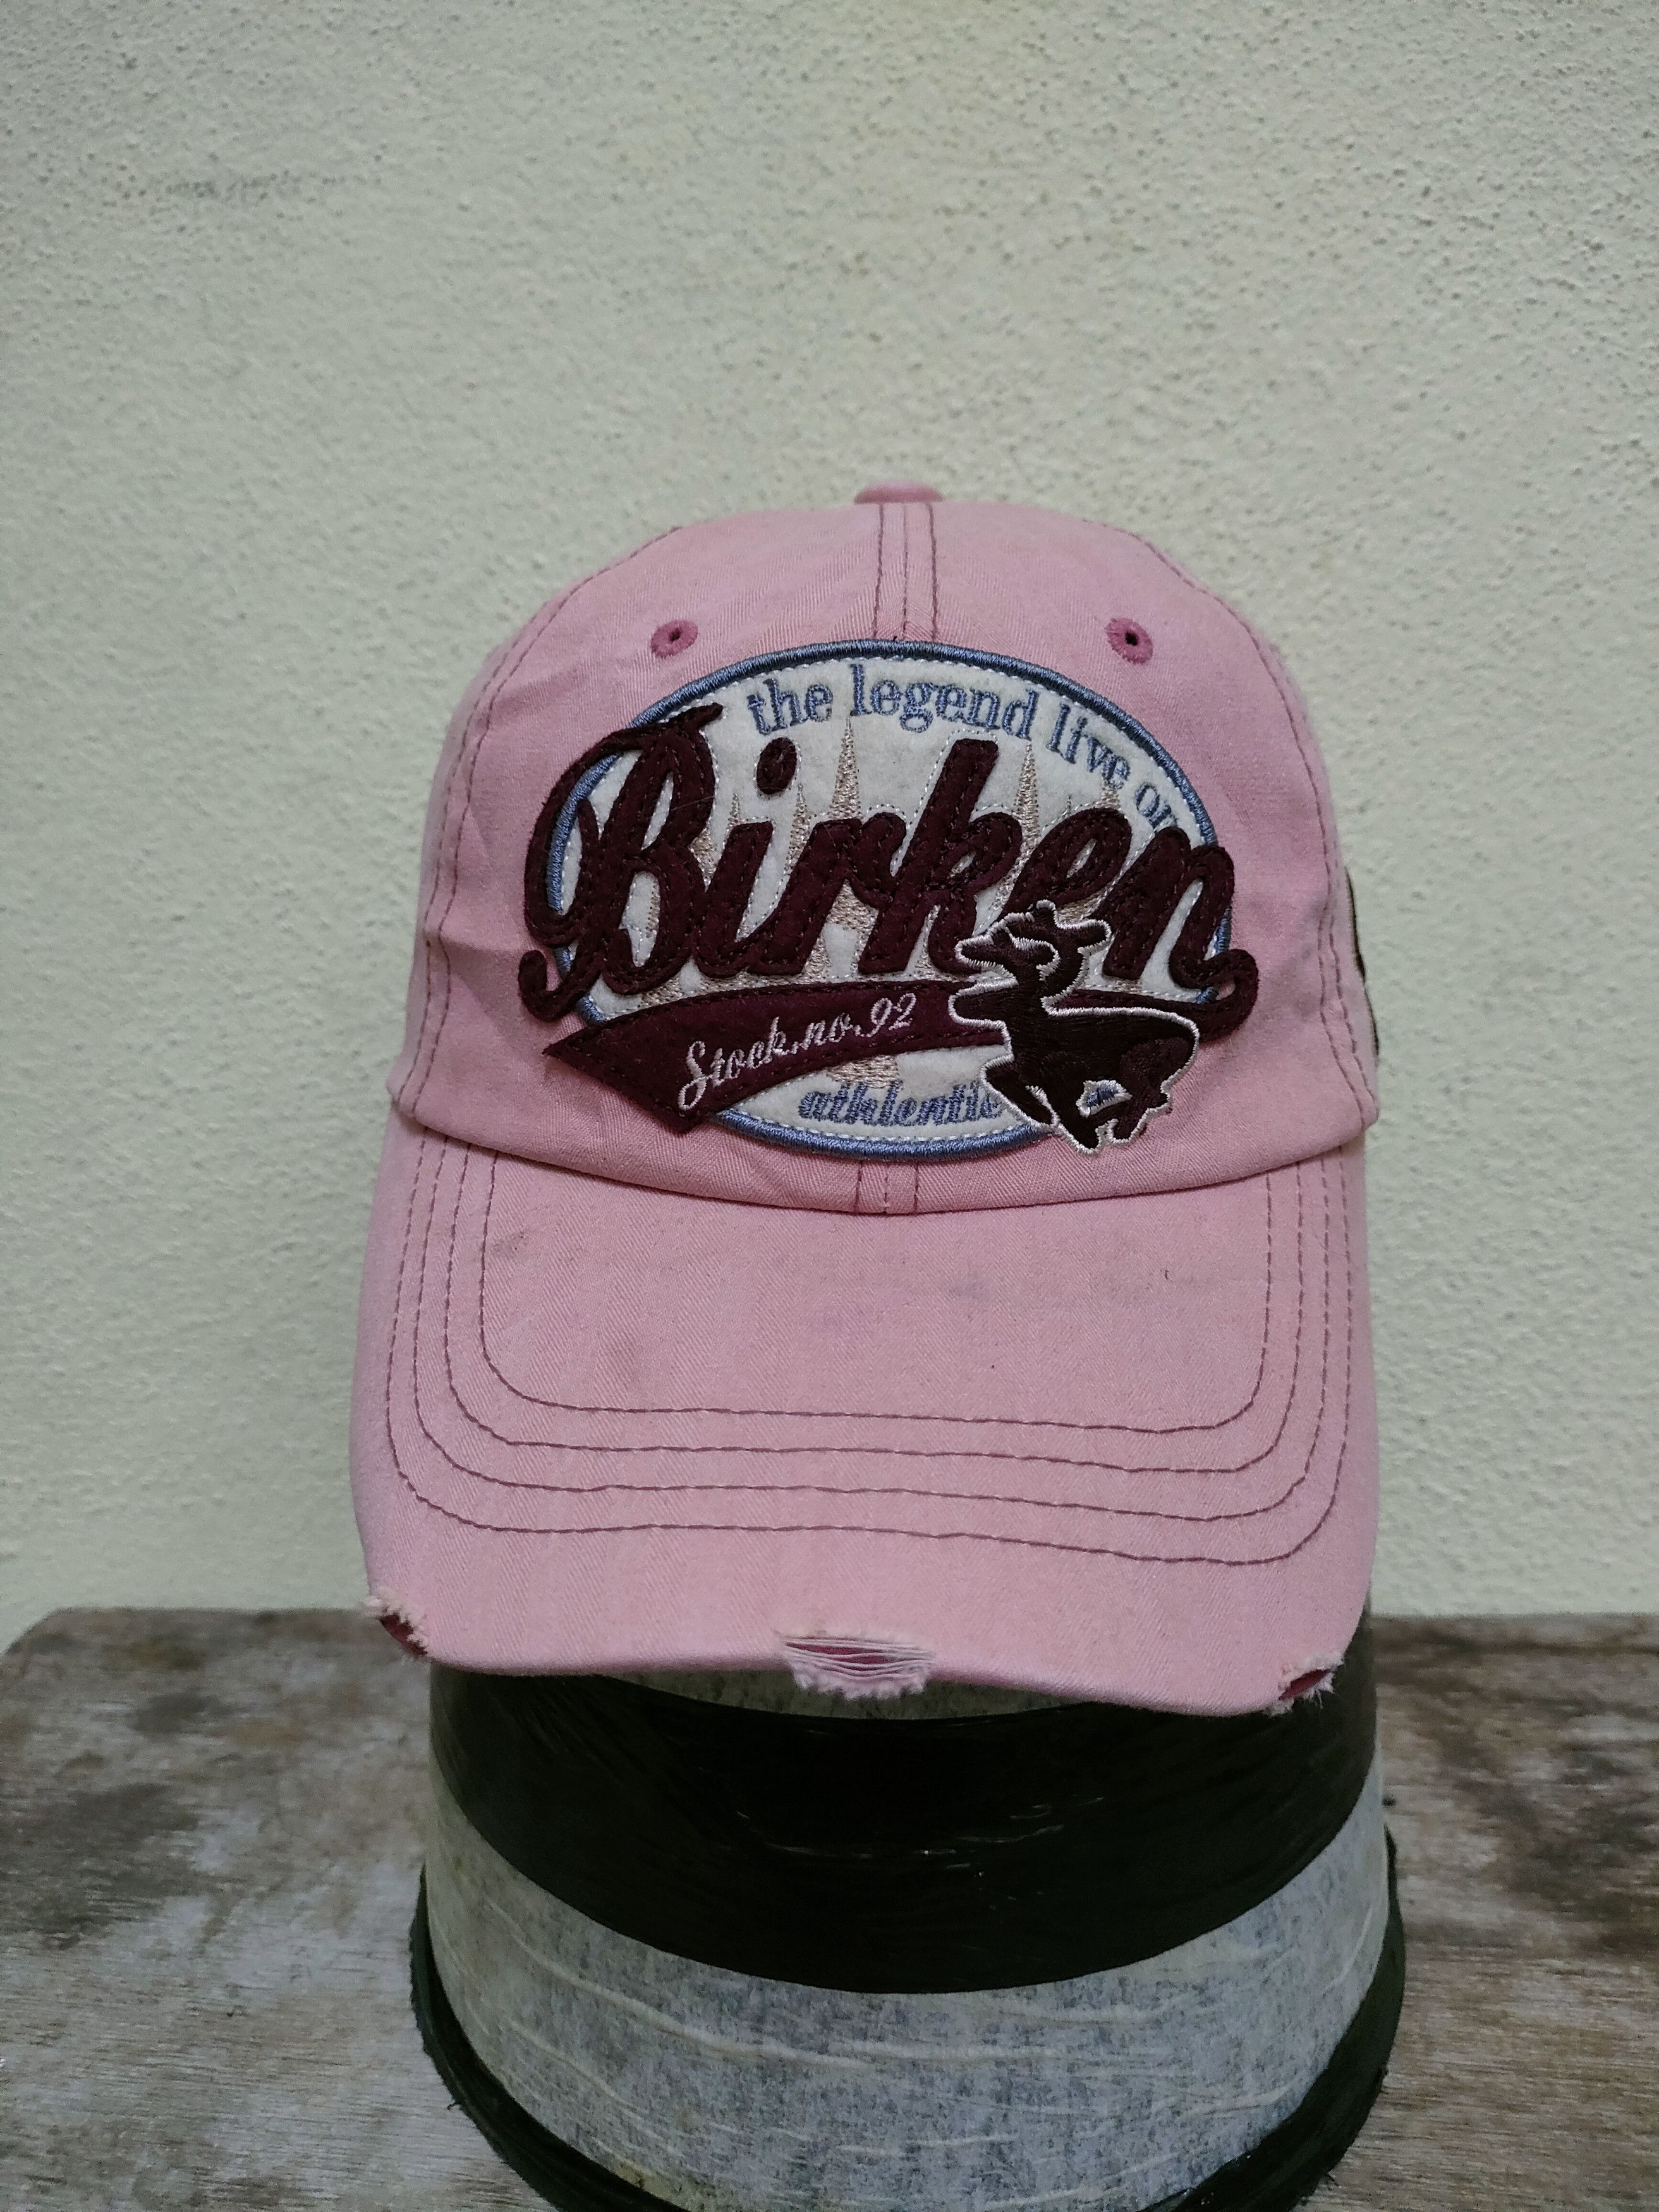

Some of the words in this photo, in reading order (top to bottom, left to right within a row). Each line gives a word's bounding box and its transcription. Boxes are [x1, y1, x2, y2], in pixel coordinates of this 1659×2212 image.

[746, 678, 834, 736] the
[849, 664, 1040, 741] legend
[1046, 703, 1131, 790] live
[519, 702, 1259, 1021] Birken
